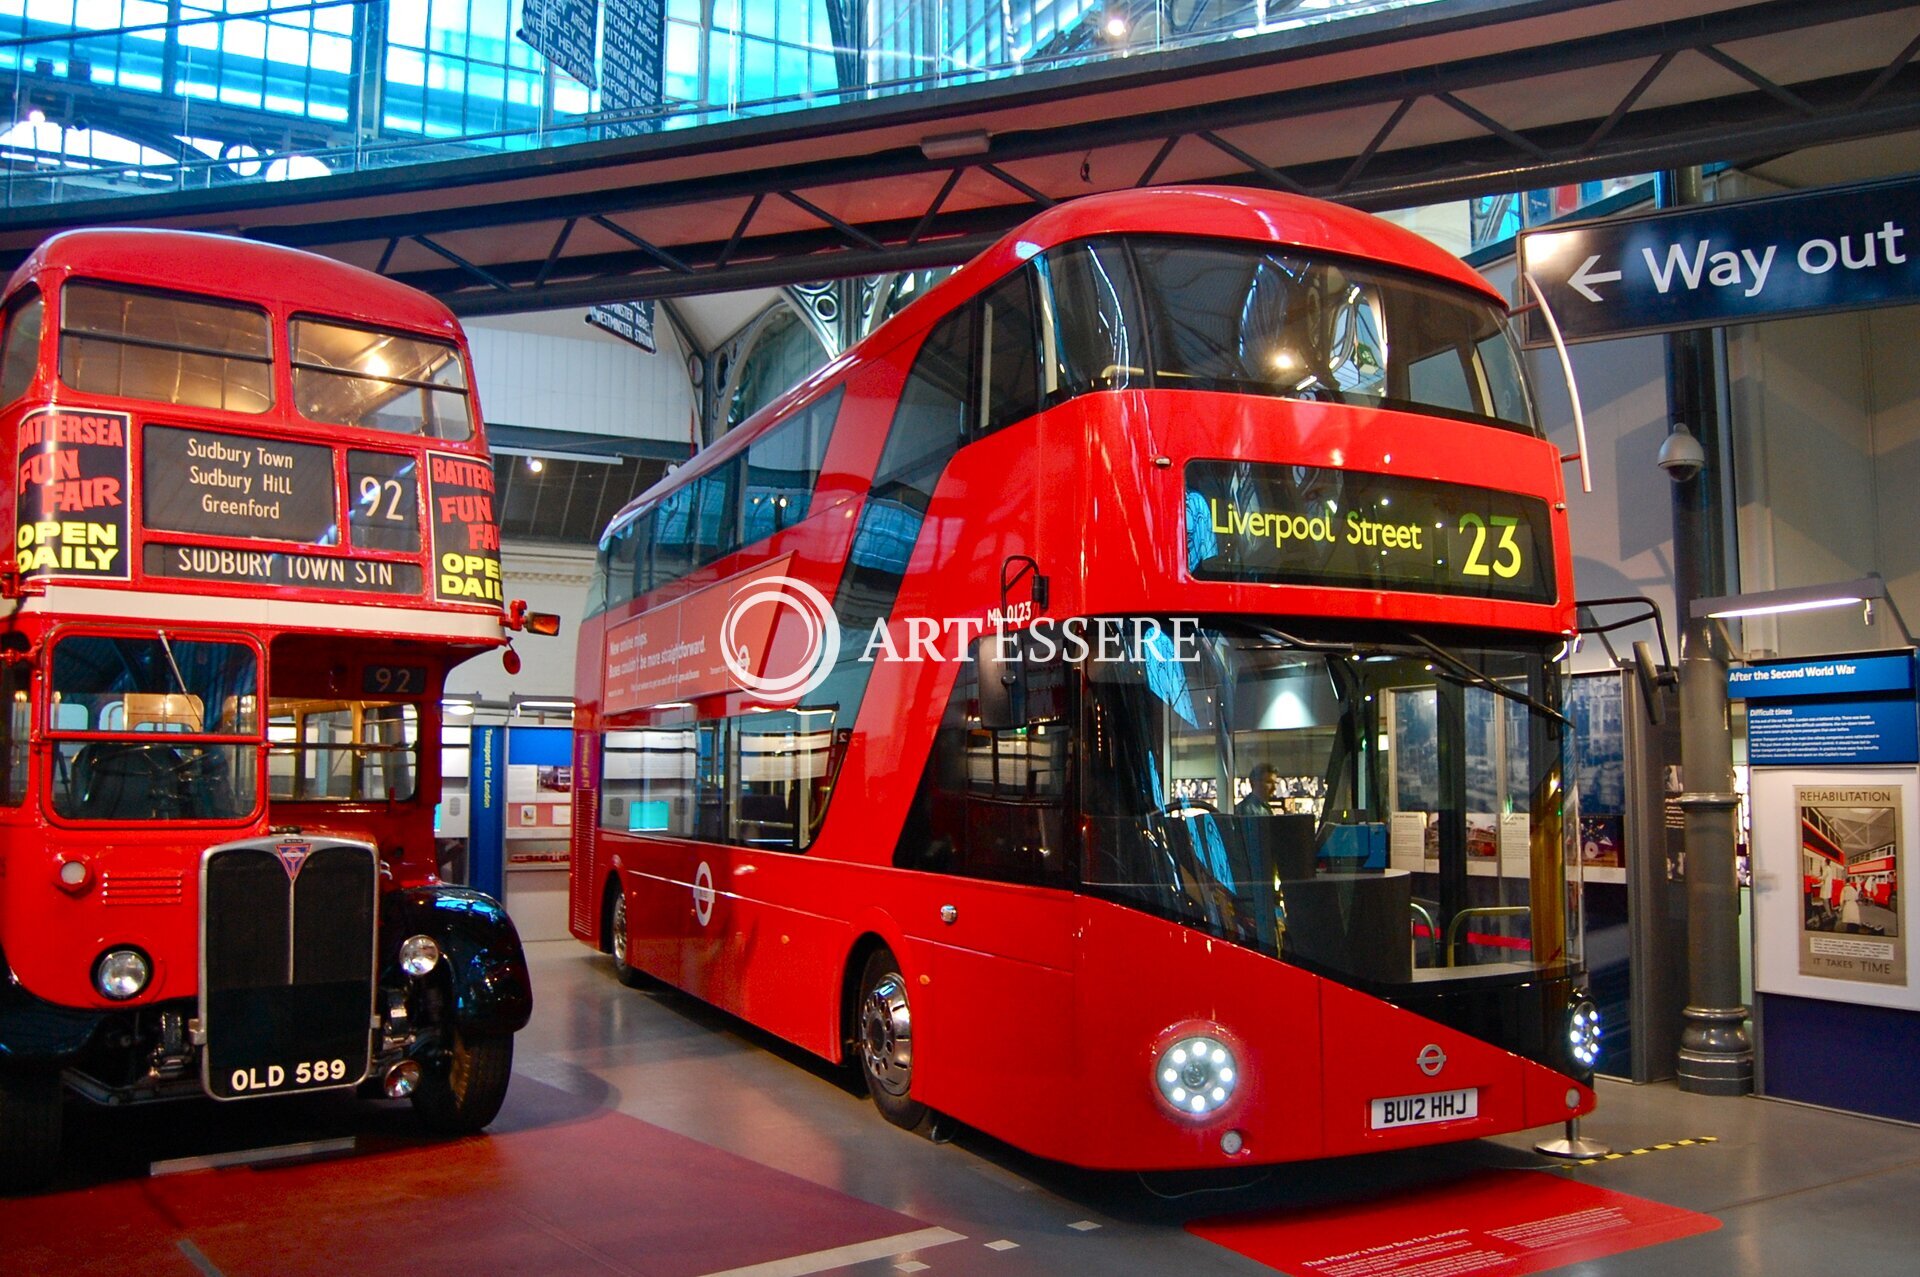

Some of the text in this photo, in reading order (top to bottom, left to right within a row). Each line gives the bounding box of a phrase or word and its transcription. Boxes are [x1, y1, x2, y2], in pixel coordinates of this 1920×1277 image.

[604, 0, 636, 27] ARBLE
[603, 41, 630, 70] ORWOOD
[602, 56, 627, 84] OTTING
[1642, 221, 1907, 297] Way out
[187, 438, 293, 469] Sudbury Town
[19, 449, 81, 495] FUN
[189, 465, 292, 495] Sudbury Hill
[42, 476, 122, 514] FAIR
[202, 494, 280, 520] Greenford
[359, 477, 404, 521] 92
[439, 495, 493, 523] FUN
[18, 521, 117, 549] OPEN
[467, 523, 500, 551] FAI
[1211, 498, 1522, 578] Liverpool Street 23
[17, 546, 119, 574] DAILY
[178, 548, 393, 586] SUDBURY TOWN STN
[442, 552, 501, 581] OPE
[441, 574, 504, 602] DAIL
[375, 667, 411, 692] 92
[1729, 664, 1856, 682] After the Second World War
[483, 728, 493, 808] Transport for London
[1800, 790, 1891, 803] REHABILITATION
[1813, 957, 1891, 975] IT TAKES TIME
[231, 1058, 346, 1091] OLD 589
[1384, 1094, 1467, 1124] BU12 HHJ
[1302, 1258, 1326, 1268] The
